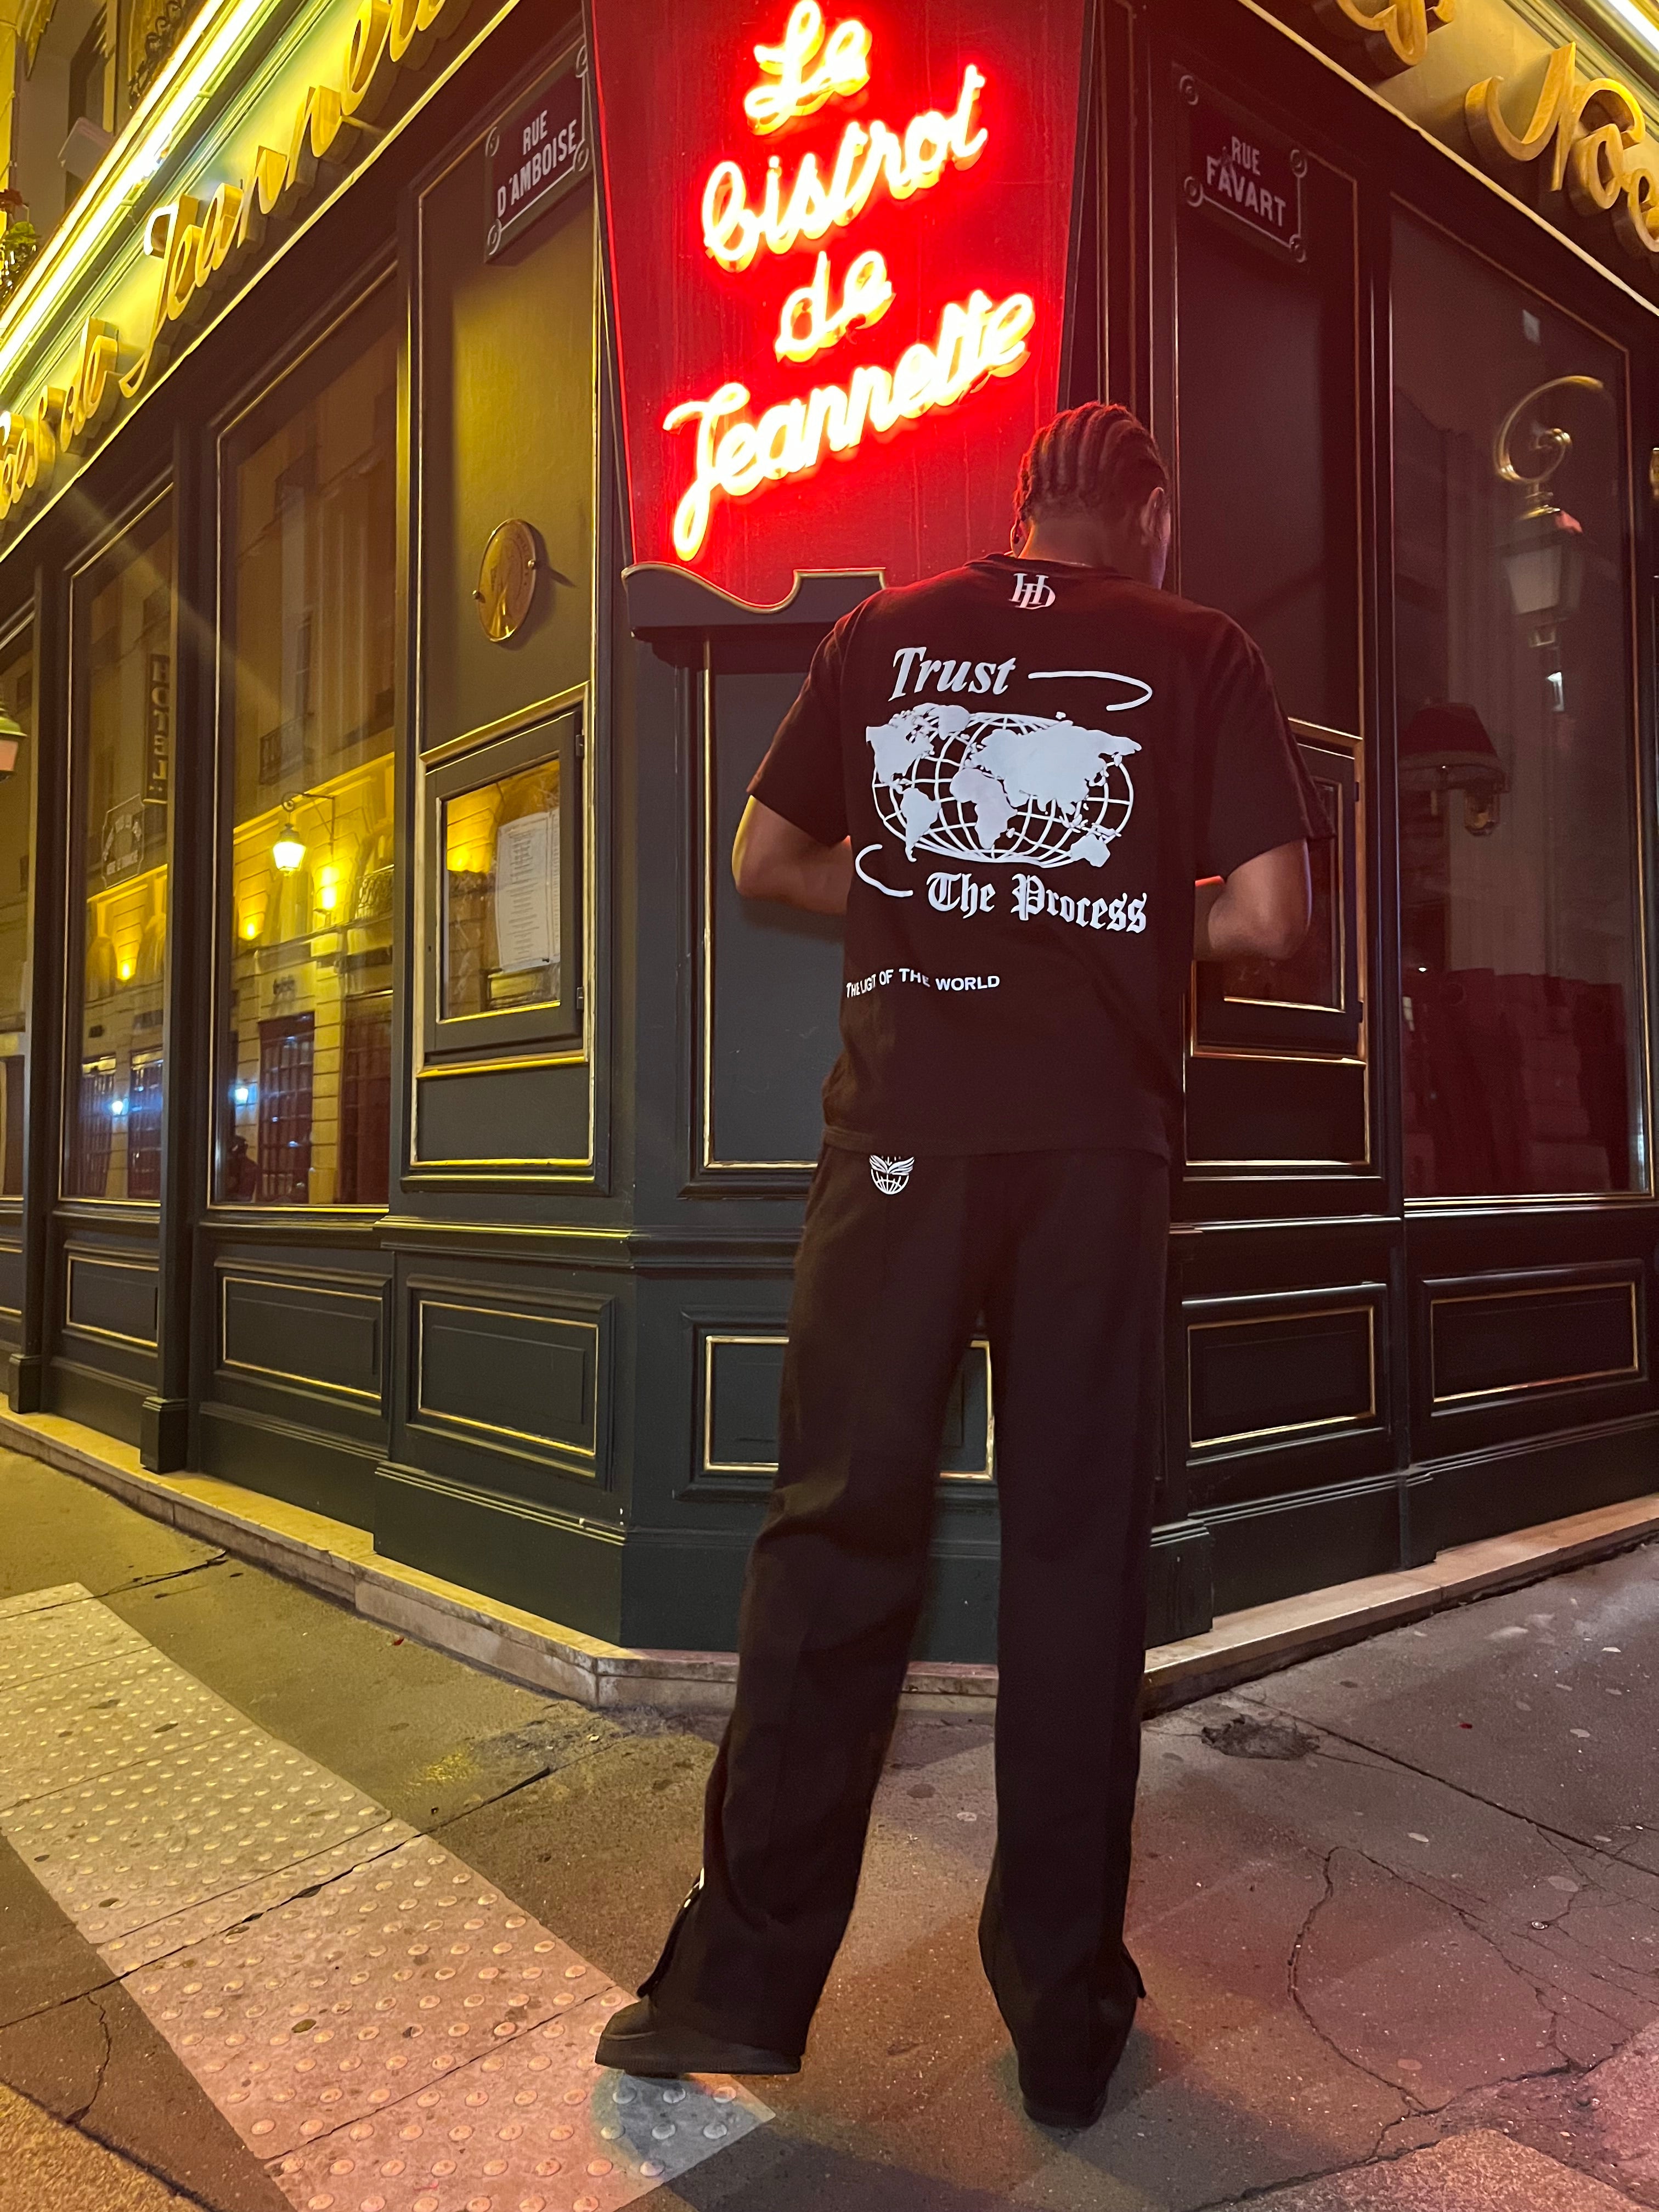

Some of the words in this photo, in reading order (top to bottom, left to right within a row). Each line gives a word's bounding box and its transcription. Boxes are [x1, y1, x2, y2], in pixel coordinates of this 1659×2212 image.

[744, 0, 872, 135] Le
[497, 119, 577, 218] D'AMBOISE
[523, 110, 548, 156] RUE
[702, 64, 988, 272] bistrot
[1231, 136, 1261, 176] RUE
[1206, 155, 1286, 228] FAVART
[774, 251, 896, 363] de
[663, 290, 1035, 561] Jeannette
[888, 646, 1016, 702] Trust
[926, 872, 995, 919] The
[1011, 873, 1147, 934] Process
[846, 982, 860, 998] THE
[879, 969, 894, 986] OF
[899, 968, 930, 988] THE
[935, 975, 1000, 991] WORLD
